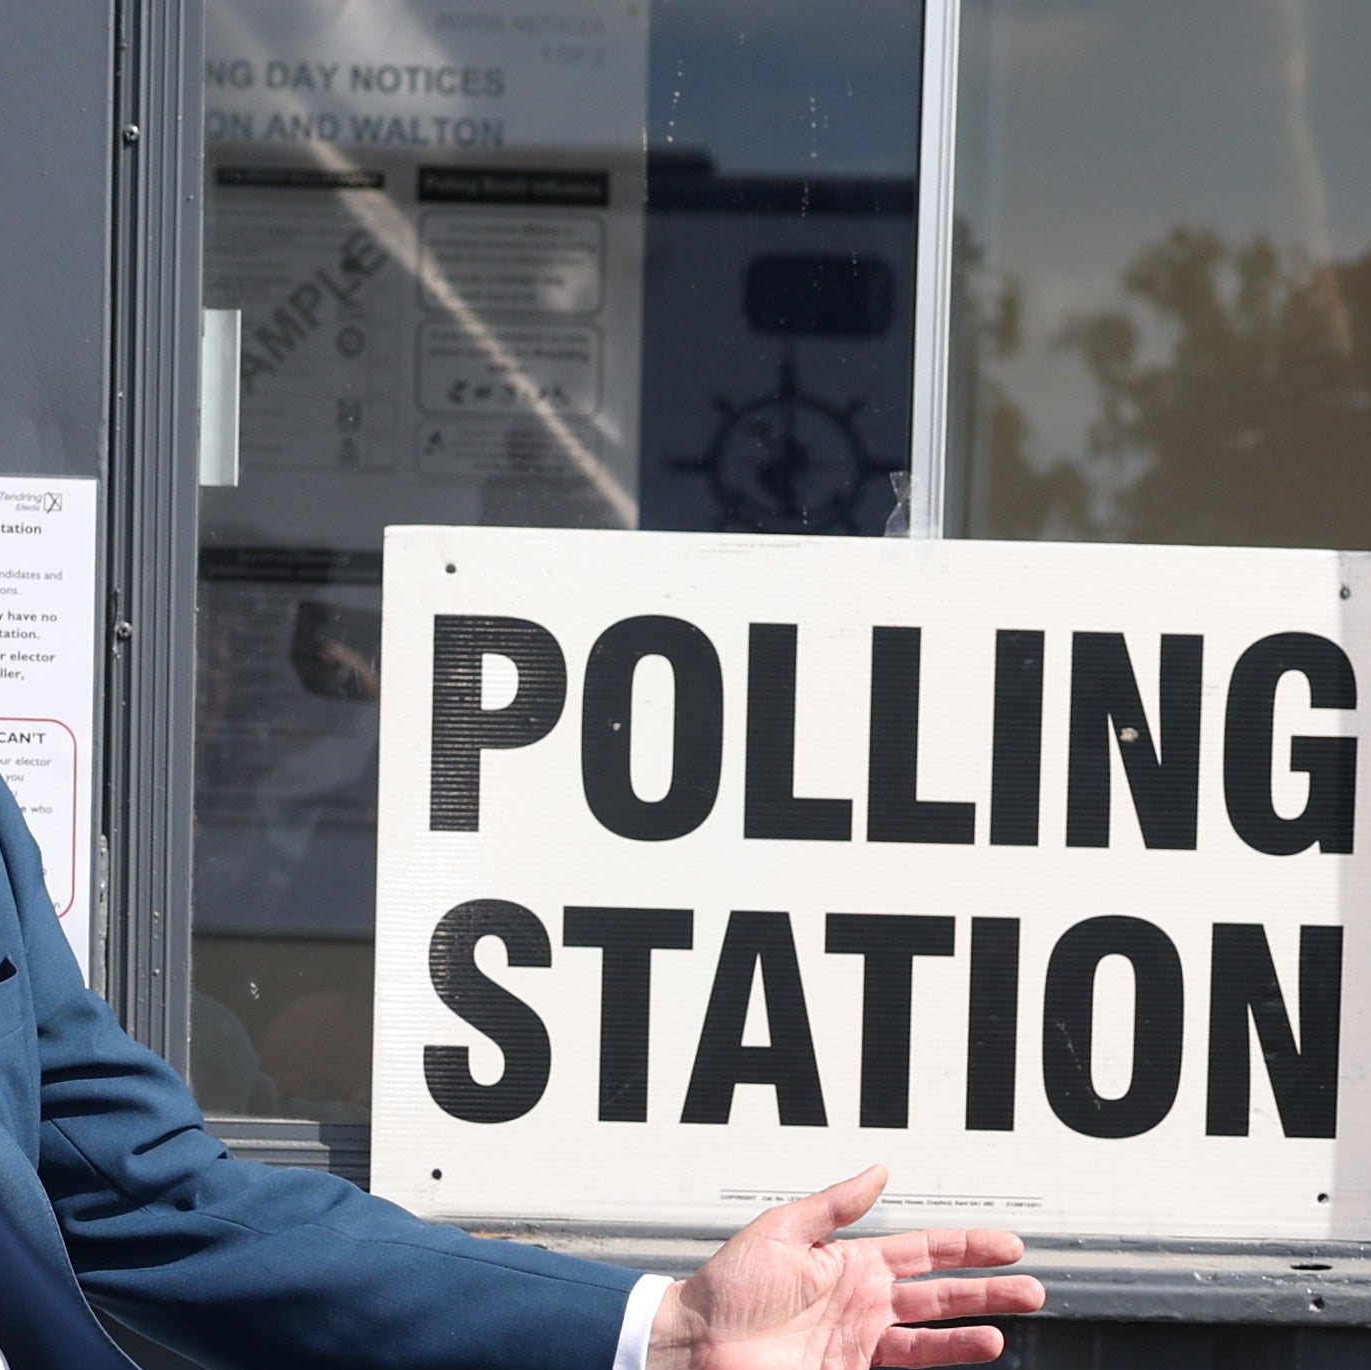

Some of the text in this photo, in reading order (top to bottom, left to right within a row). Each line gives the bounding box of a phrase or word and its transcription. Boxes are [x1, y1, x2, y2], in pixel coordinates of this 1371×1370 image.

[204, 59, 506, 97] NG DAY NOTICES
[204, 109, 505, 146] ON AND WALTON
[240, 229, 391, 394] AMPLE
[0, 491, 43, 504] Tendring
[44, 570, 63, 580] and
[8, 611, 37, 621] have
[41, 613, 58, 622] no
[10, 651, 56, 662] elector
[430, 614, 1358, 856] POLLING
[15, 756, 52, 767] elector
[31, 804, 53, 814] who
[423, 898, 1344, 1140] STATION
